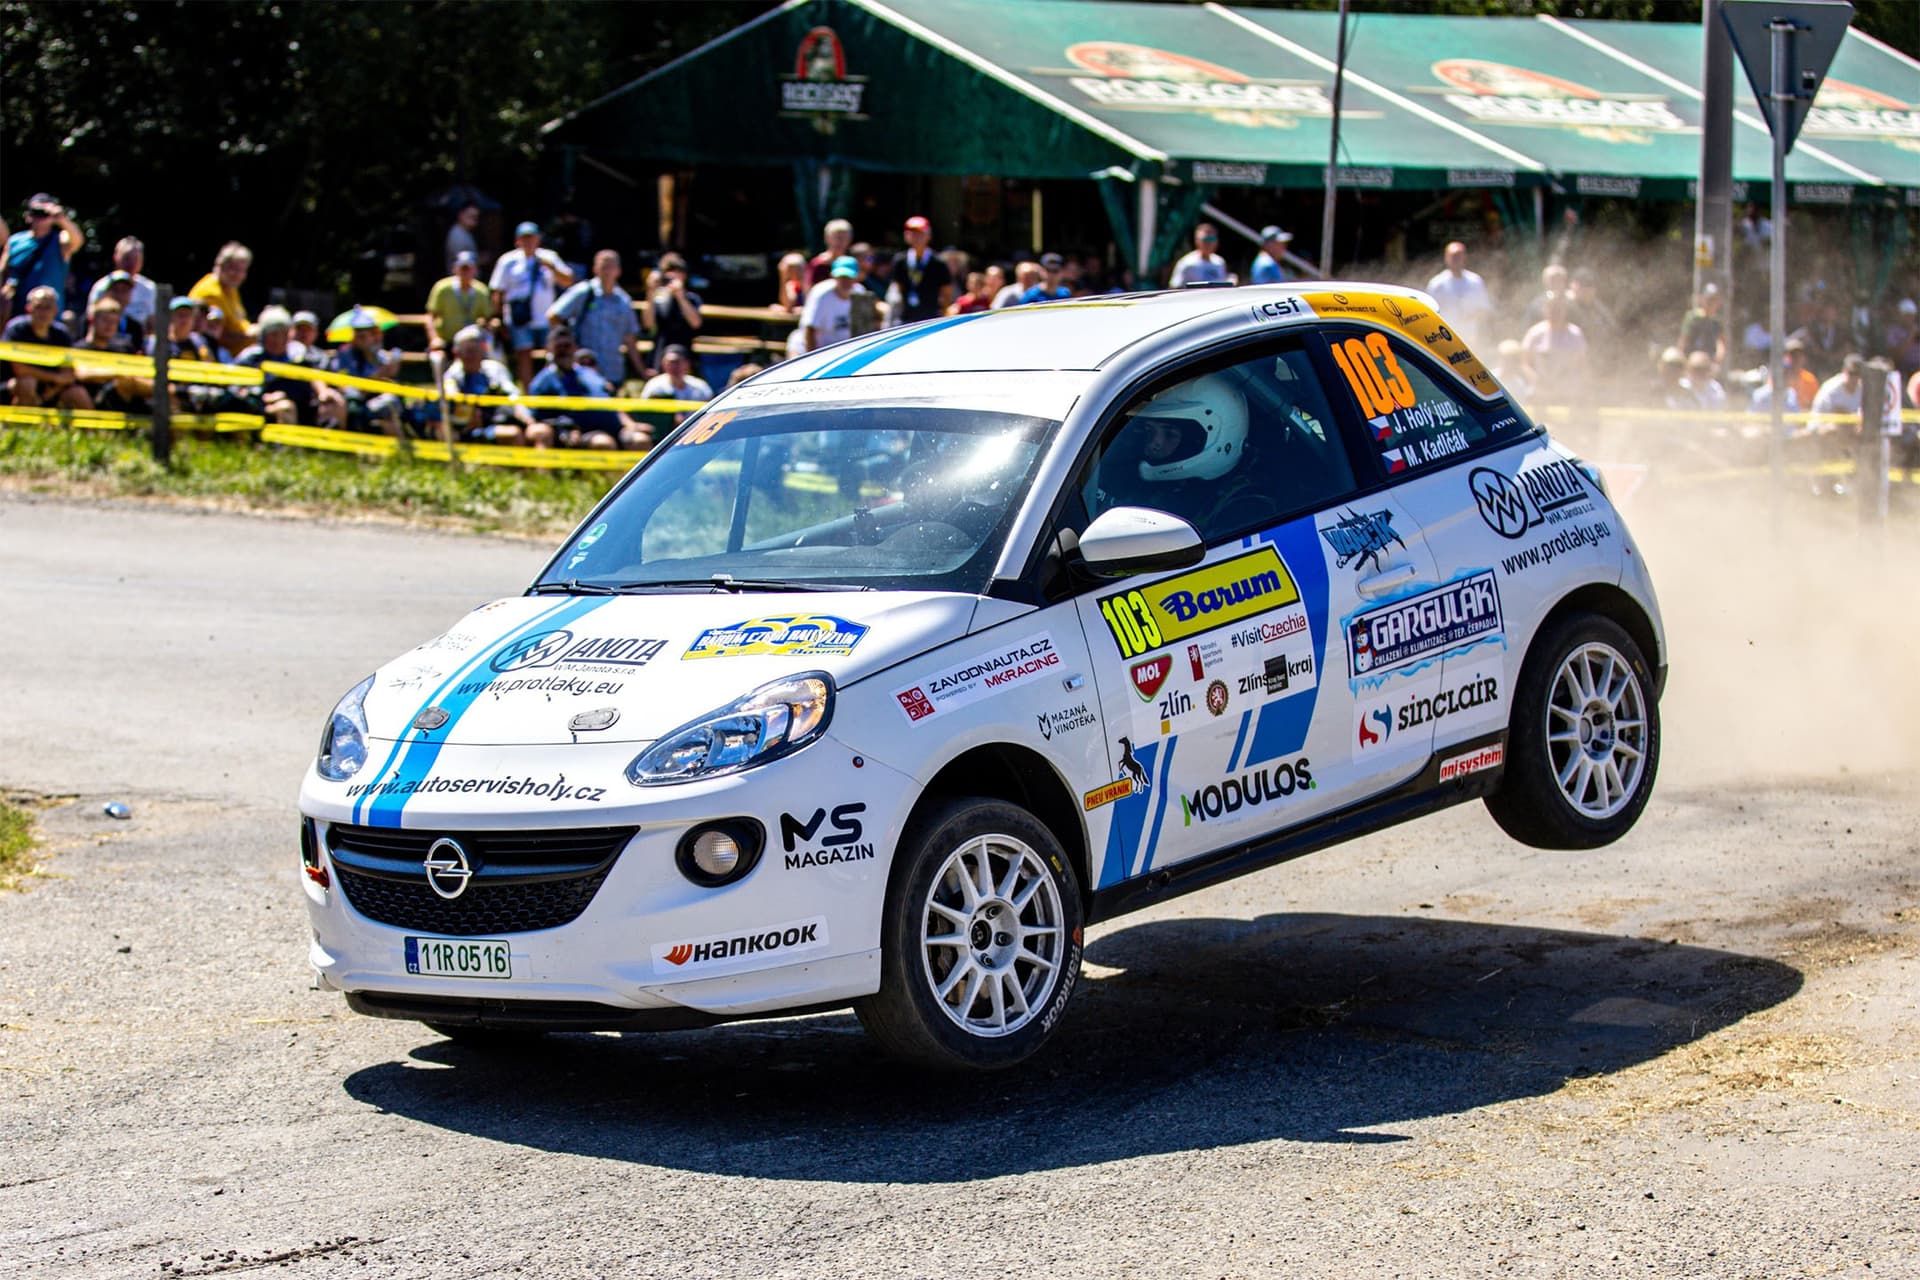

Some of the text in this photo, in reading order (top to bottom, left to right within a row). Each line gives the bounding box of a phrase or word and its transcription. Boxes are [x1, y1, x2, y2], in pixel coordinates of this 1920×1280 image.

[1331, 332, 1416, 420] 103
[1392, 400, 1460, 434] J. Holý jun.
[1403, 444, 1423, 468] M.
[1516, 459, 1585, 528] JANOTA
[1501, 521, 1611, 576] www.protlaky.eu
[1160, 570, 1282, 622] Barum
[1102, 590, 1162, 658] 103
[1371, 578, 1494, 651] GARGULÁK
[1231, 613, 1307, 648] #VisitCzechia
[1410, 633, 1447, 654] KLIMATIZACE
[1467, 616, 1497, 635] ČERPADLA
[528, 638, 669, 668] JANOTA
[929, 639, 1053, 694] ZAVODNIAUTA.CZ
[1288, 654, 1313, 678] kraj
[457, 675, 625, 697] www.protlaky.eu
[1136, 662, 1161, 685] MOL
[935, 682, 977, 702] POWERED BY
[1051, 701, 1088, 723] MAZANÁ
[346, 775, 607, 802] www.autoservisholy.cz
[1086, 794, 1104, 809] PNEU
[780, 802, 867, 852] MS
[784, 843, 875, 870] MAGAZIN
[408, 963, 418, 973] CZ
[422, 943, 506, 973] 11R 0516
